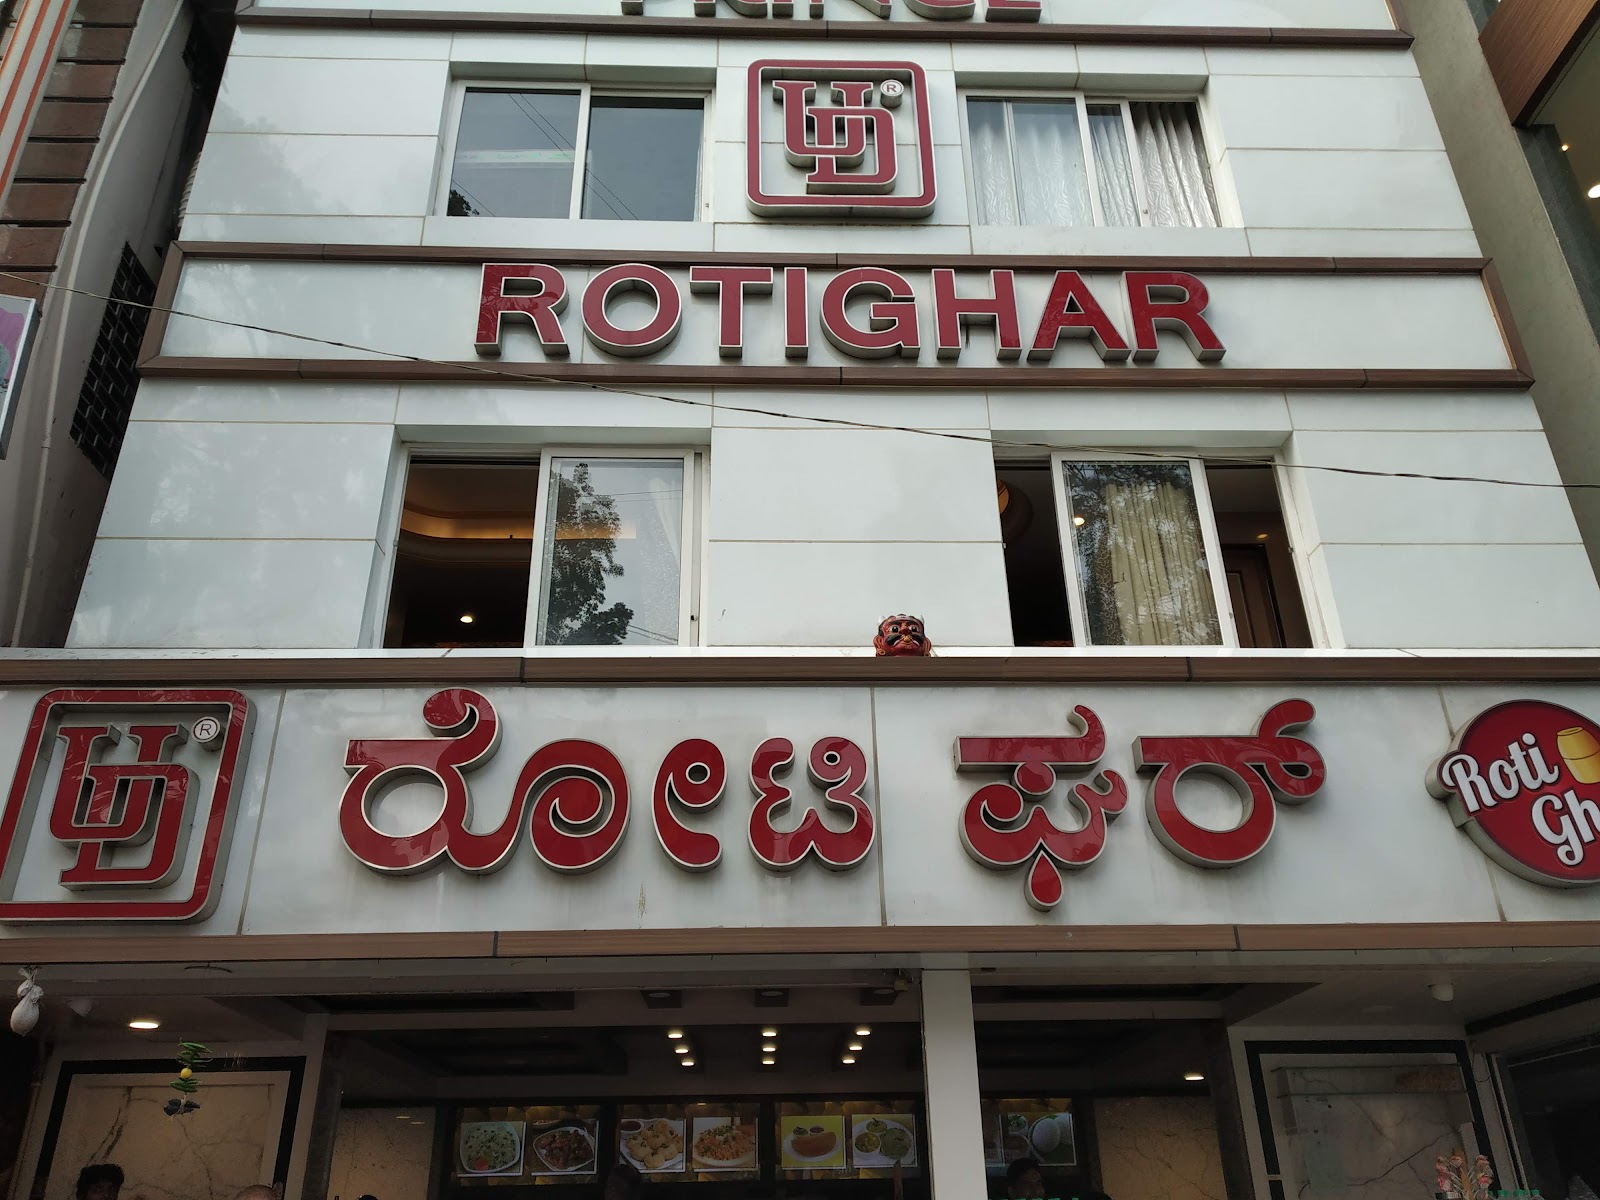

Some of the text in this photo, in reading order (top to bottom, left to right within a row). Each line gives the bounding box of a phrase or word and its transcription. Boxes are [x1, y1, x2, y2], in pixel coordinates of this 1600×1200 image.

[475, 262, 1225, 362] ROTIGHAR
[338, 687, 1327, 909] ರೋಟಿ ಘರ್
[1442, 732, 1560, 813] Roti
